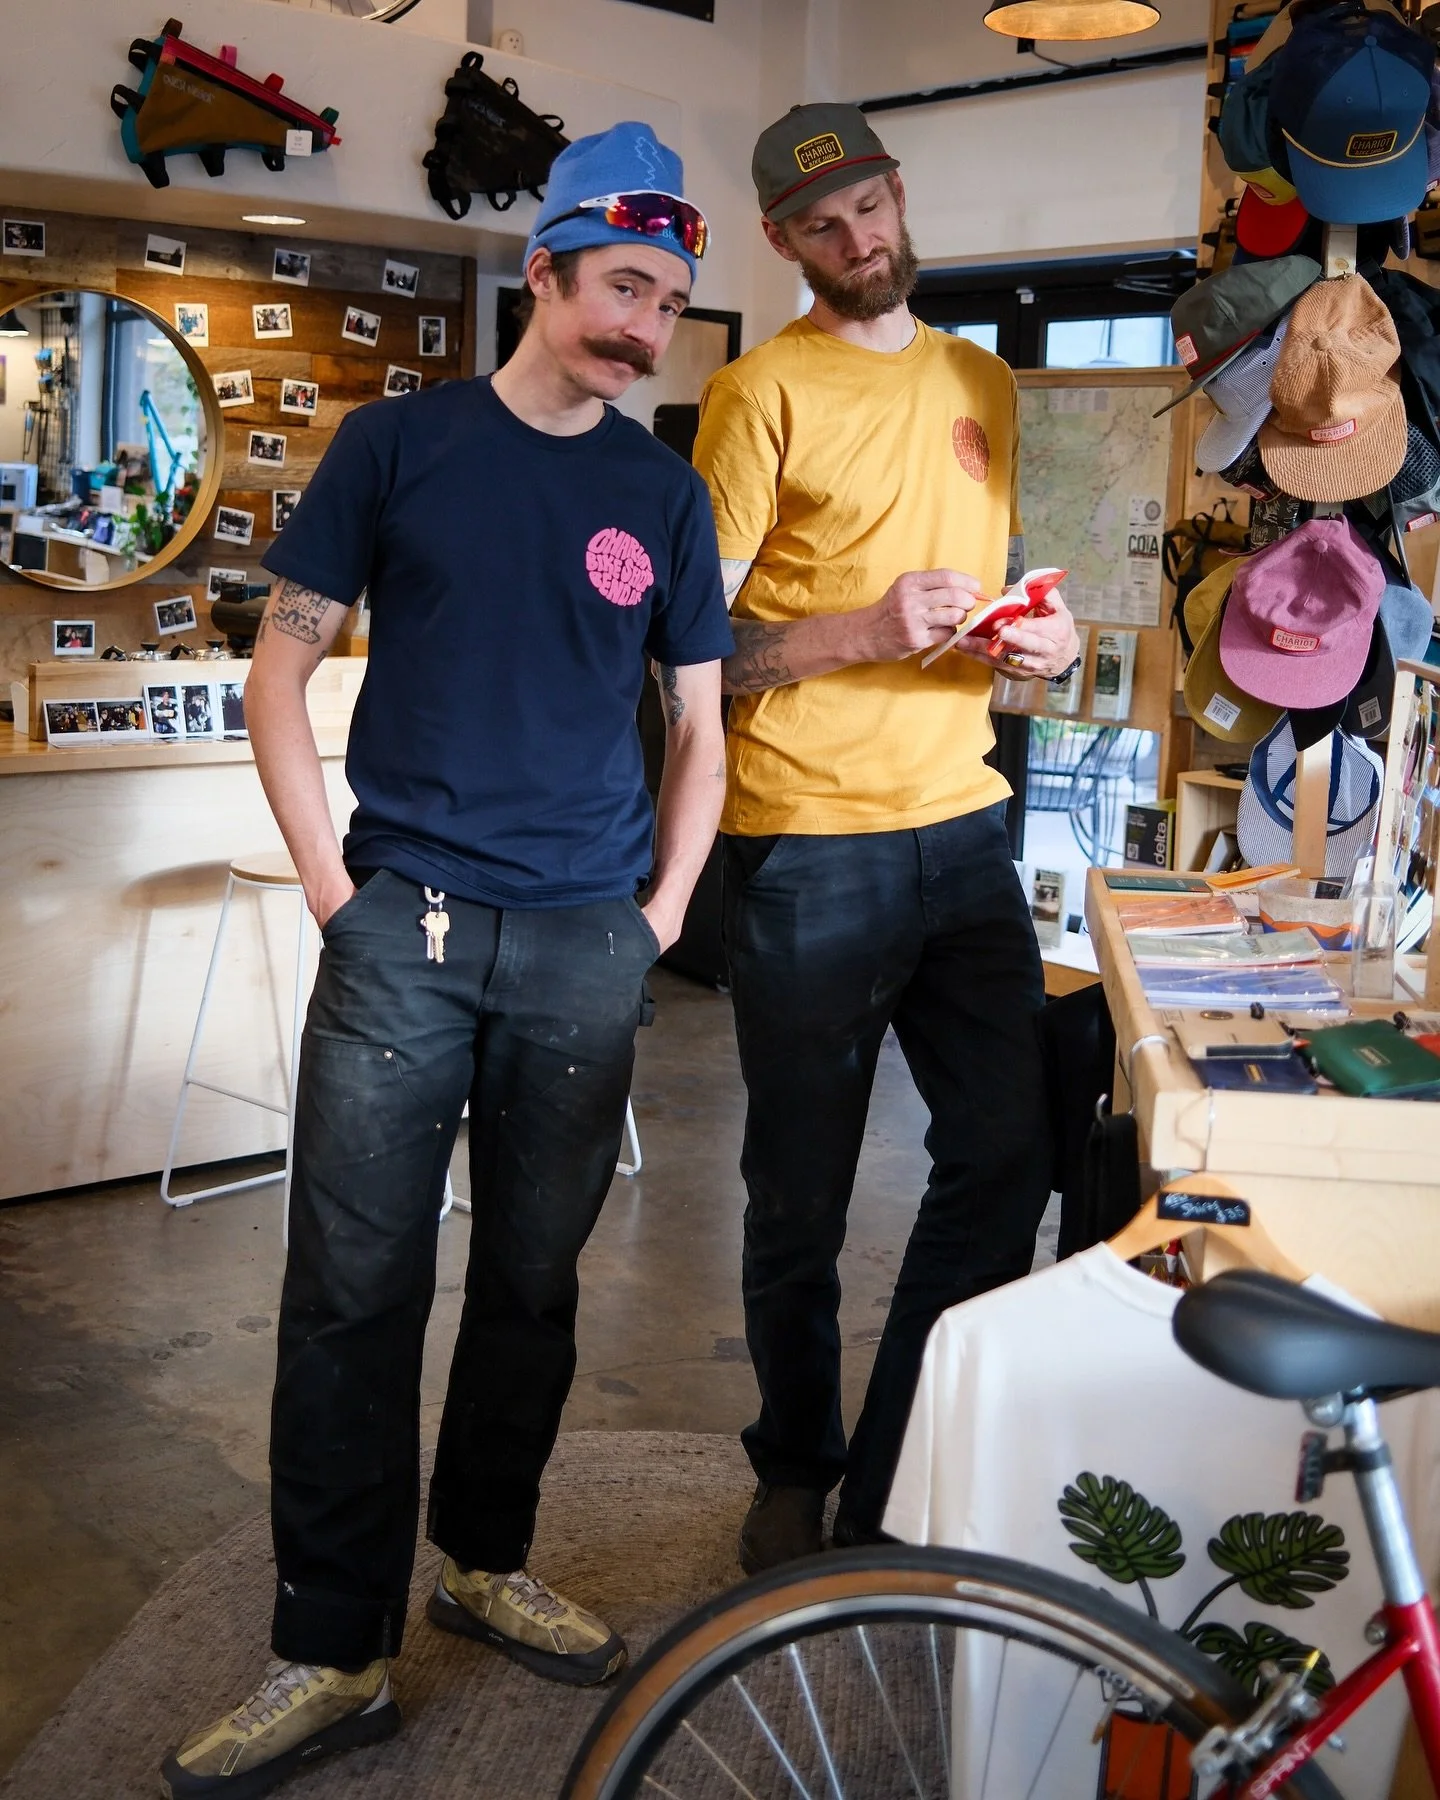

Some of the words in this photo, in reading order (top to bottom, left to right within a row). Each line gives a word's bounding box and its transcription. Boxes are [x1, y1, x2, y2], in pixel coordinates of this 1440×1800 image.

[1352, 137, 1393, 150] CHARIOT
[800, 141, 837, 164] CHARIOT
[1314, 424, 1353, 438] CHARIOT
[585, 550, 623, 580] BIKE
[1276, 634, 1314, 647] CHARIOT
